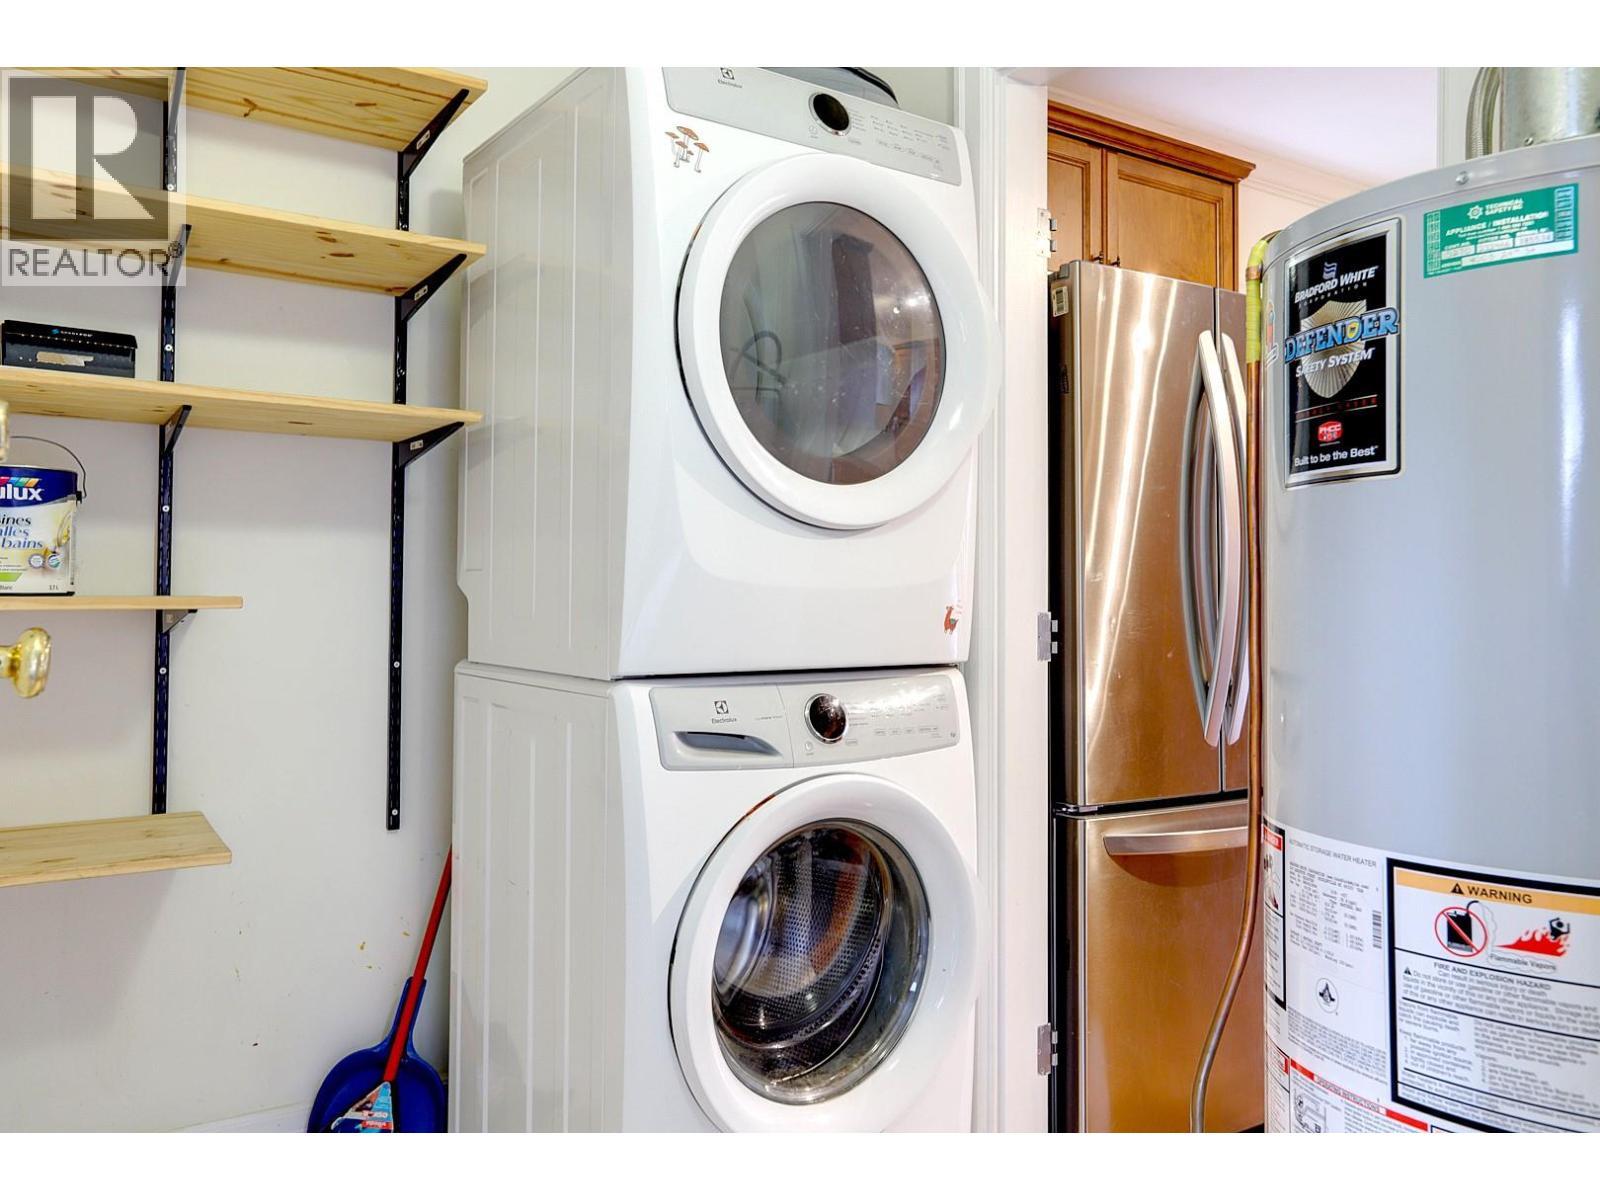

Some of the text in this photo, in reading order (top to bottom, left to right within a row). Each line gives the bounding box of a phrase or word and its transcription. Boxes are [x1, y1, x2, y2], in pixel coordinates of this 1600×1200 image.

[1294, 265, 1378, 304] BRADFORD WHITE
[1284, 307, 1400, 364] DEFENDER
[1295, 348, 1374, 378] SAFETY SYSTEM
[1294, 455, 1309, 467] Built
[1310, 454, 1318, 464] to
[1320, 452, 1331, 462] be
[1332, 450, 1348, 460] the
[2, 537, 43, 548] bains
[1333, 852, 1352, 862] WATER
[1352, 857, 1377, 868] HEATER
[1467, 885, 1533, 904] WARNING
[1434, 962, 1552, 991] FIRE AND EXPLOSION HAZARD
